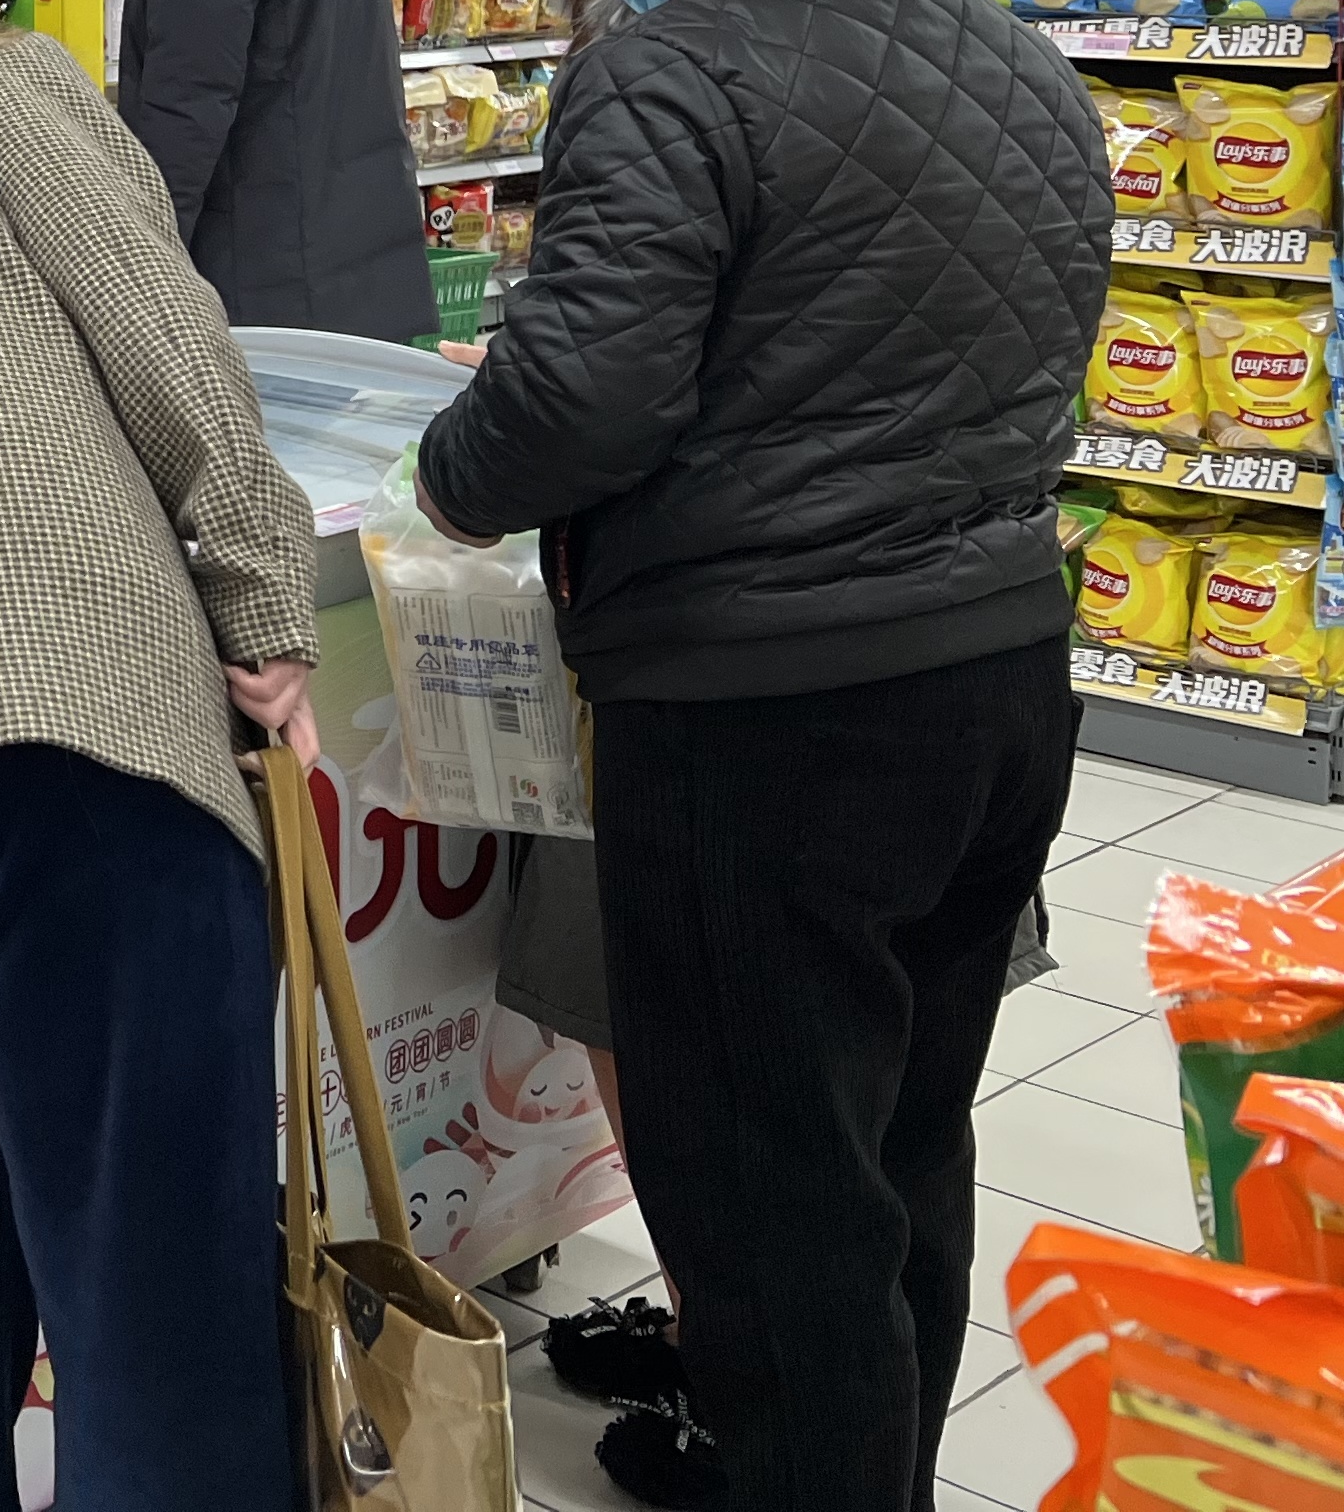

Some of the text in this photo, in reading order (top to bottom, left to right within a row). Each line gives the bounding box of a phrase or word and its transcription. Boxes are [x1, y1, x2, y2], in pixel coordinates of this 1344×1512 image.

[1188, 24, 1303, 58] 大波浪
[1191, 228, 1308, 263] 大波浪
[1181, 454, 1297, 493] 大波浪
[1153, 671, 1266, 713] 大波浪
[384, 1002, 434, 1034] FESTIVAL
